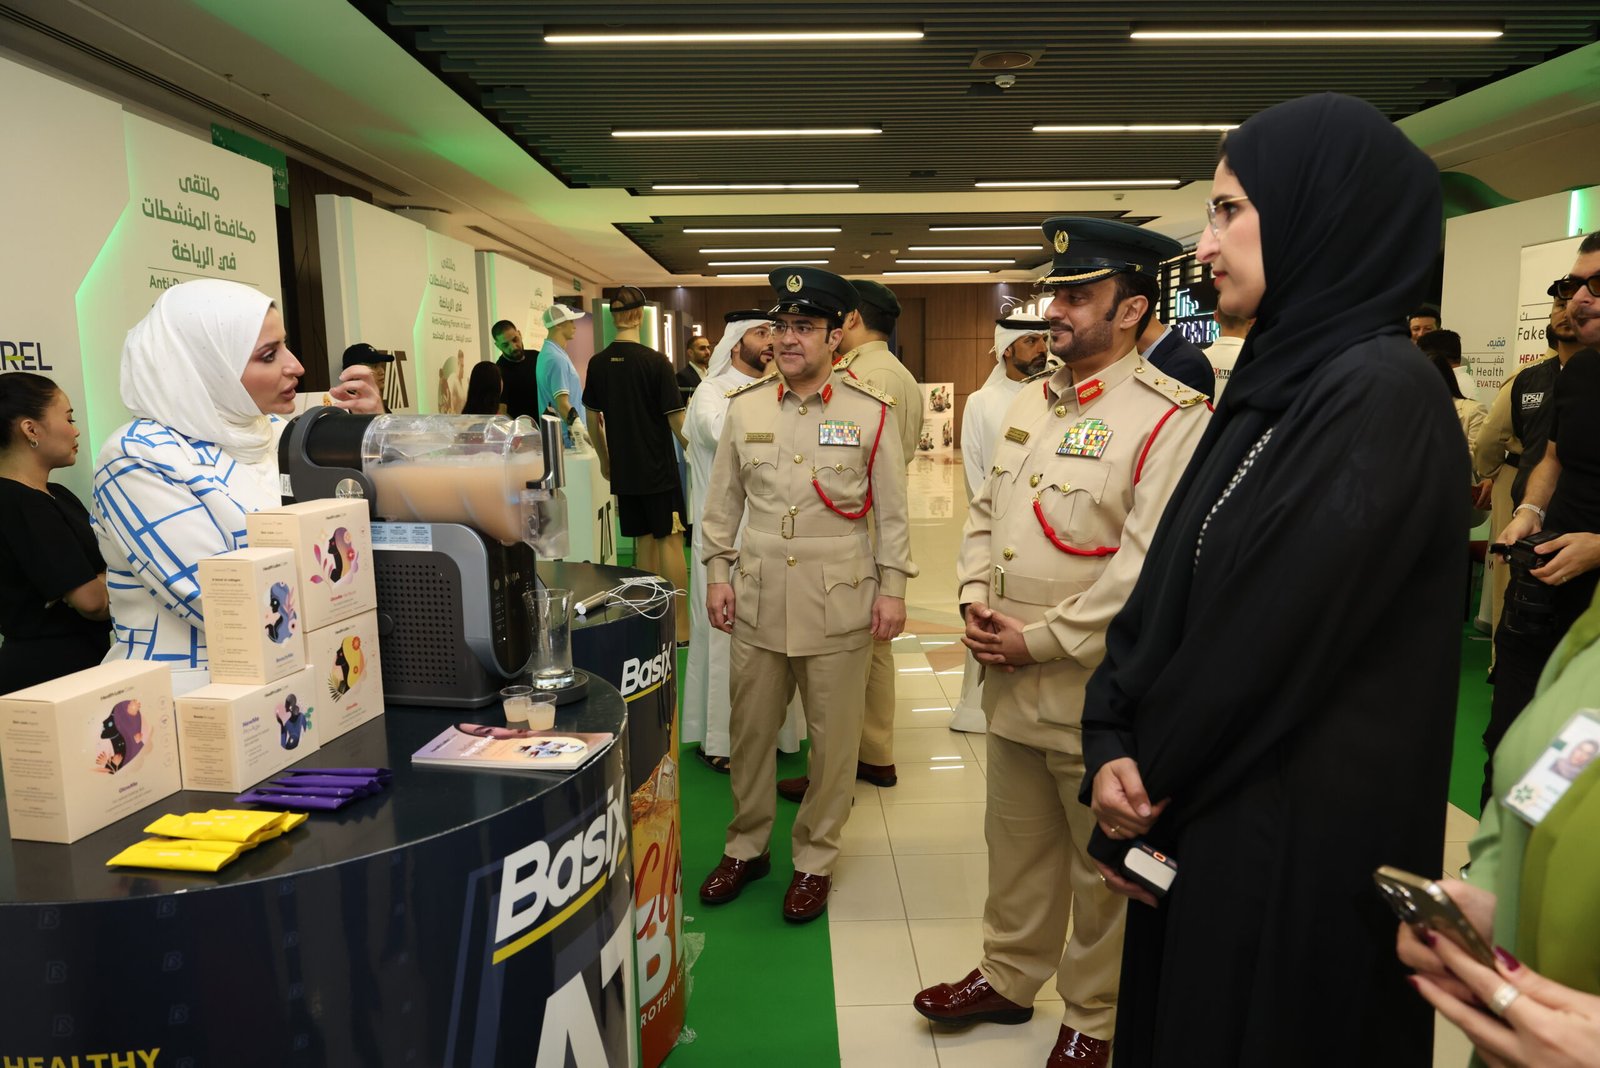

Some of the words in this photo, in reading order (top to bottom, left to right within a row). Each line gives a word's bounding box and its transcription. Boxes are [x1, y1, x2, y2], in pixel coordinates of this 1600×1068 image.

[179, 174, 220, 201] ملتقى
[141, 197, 211, 232] المنشطات
[214, 214, 256, 244] مكافحة
[172, 239, 215, 270] الرياضة
[218, 251, 237, 271] في
[1518, 326, 1545, 341] Fake
[0, 340, 53, 371] REL
[1476, 367, 1504, 377] Health
[620, 641, 672, 696] Basix
[494, 776, 628, 945] Basix
[640, 980, 676, 1029] ROTEIN
